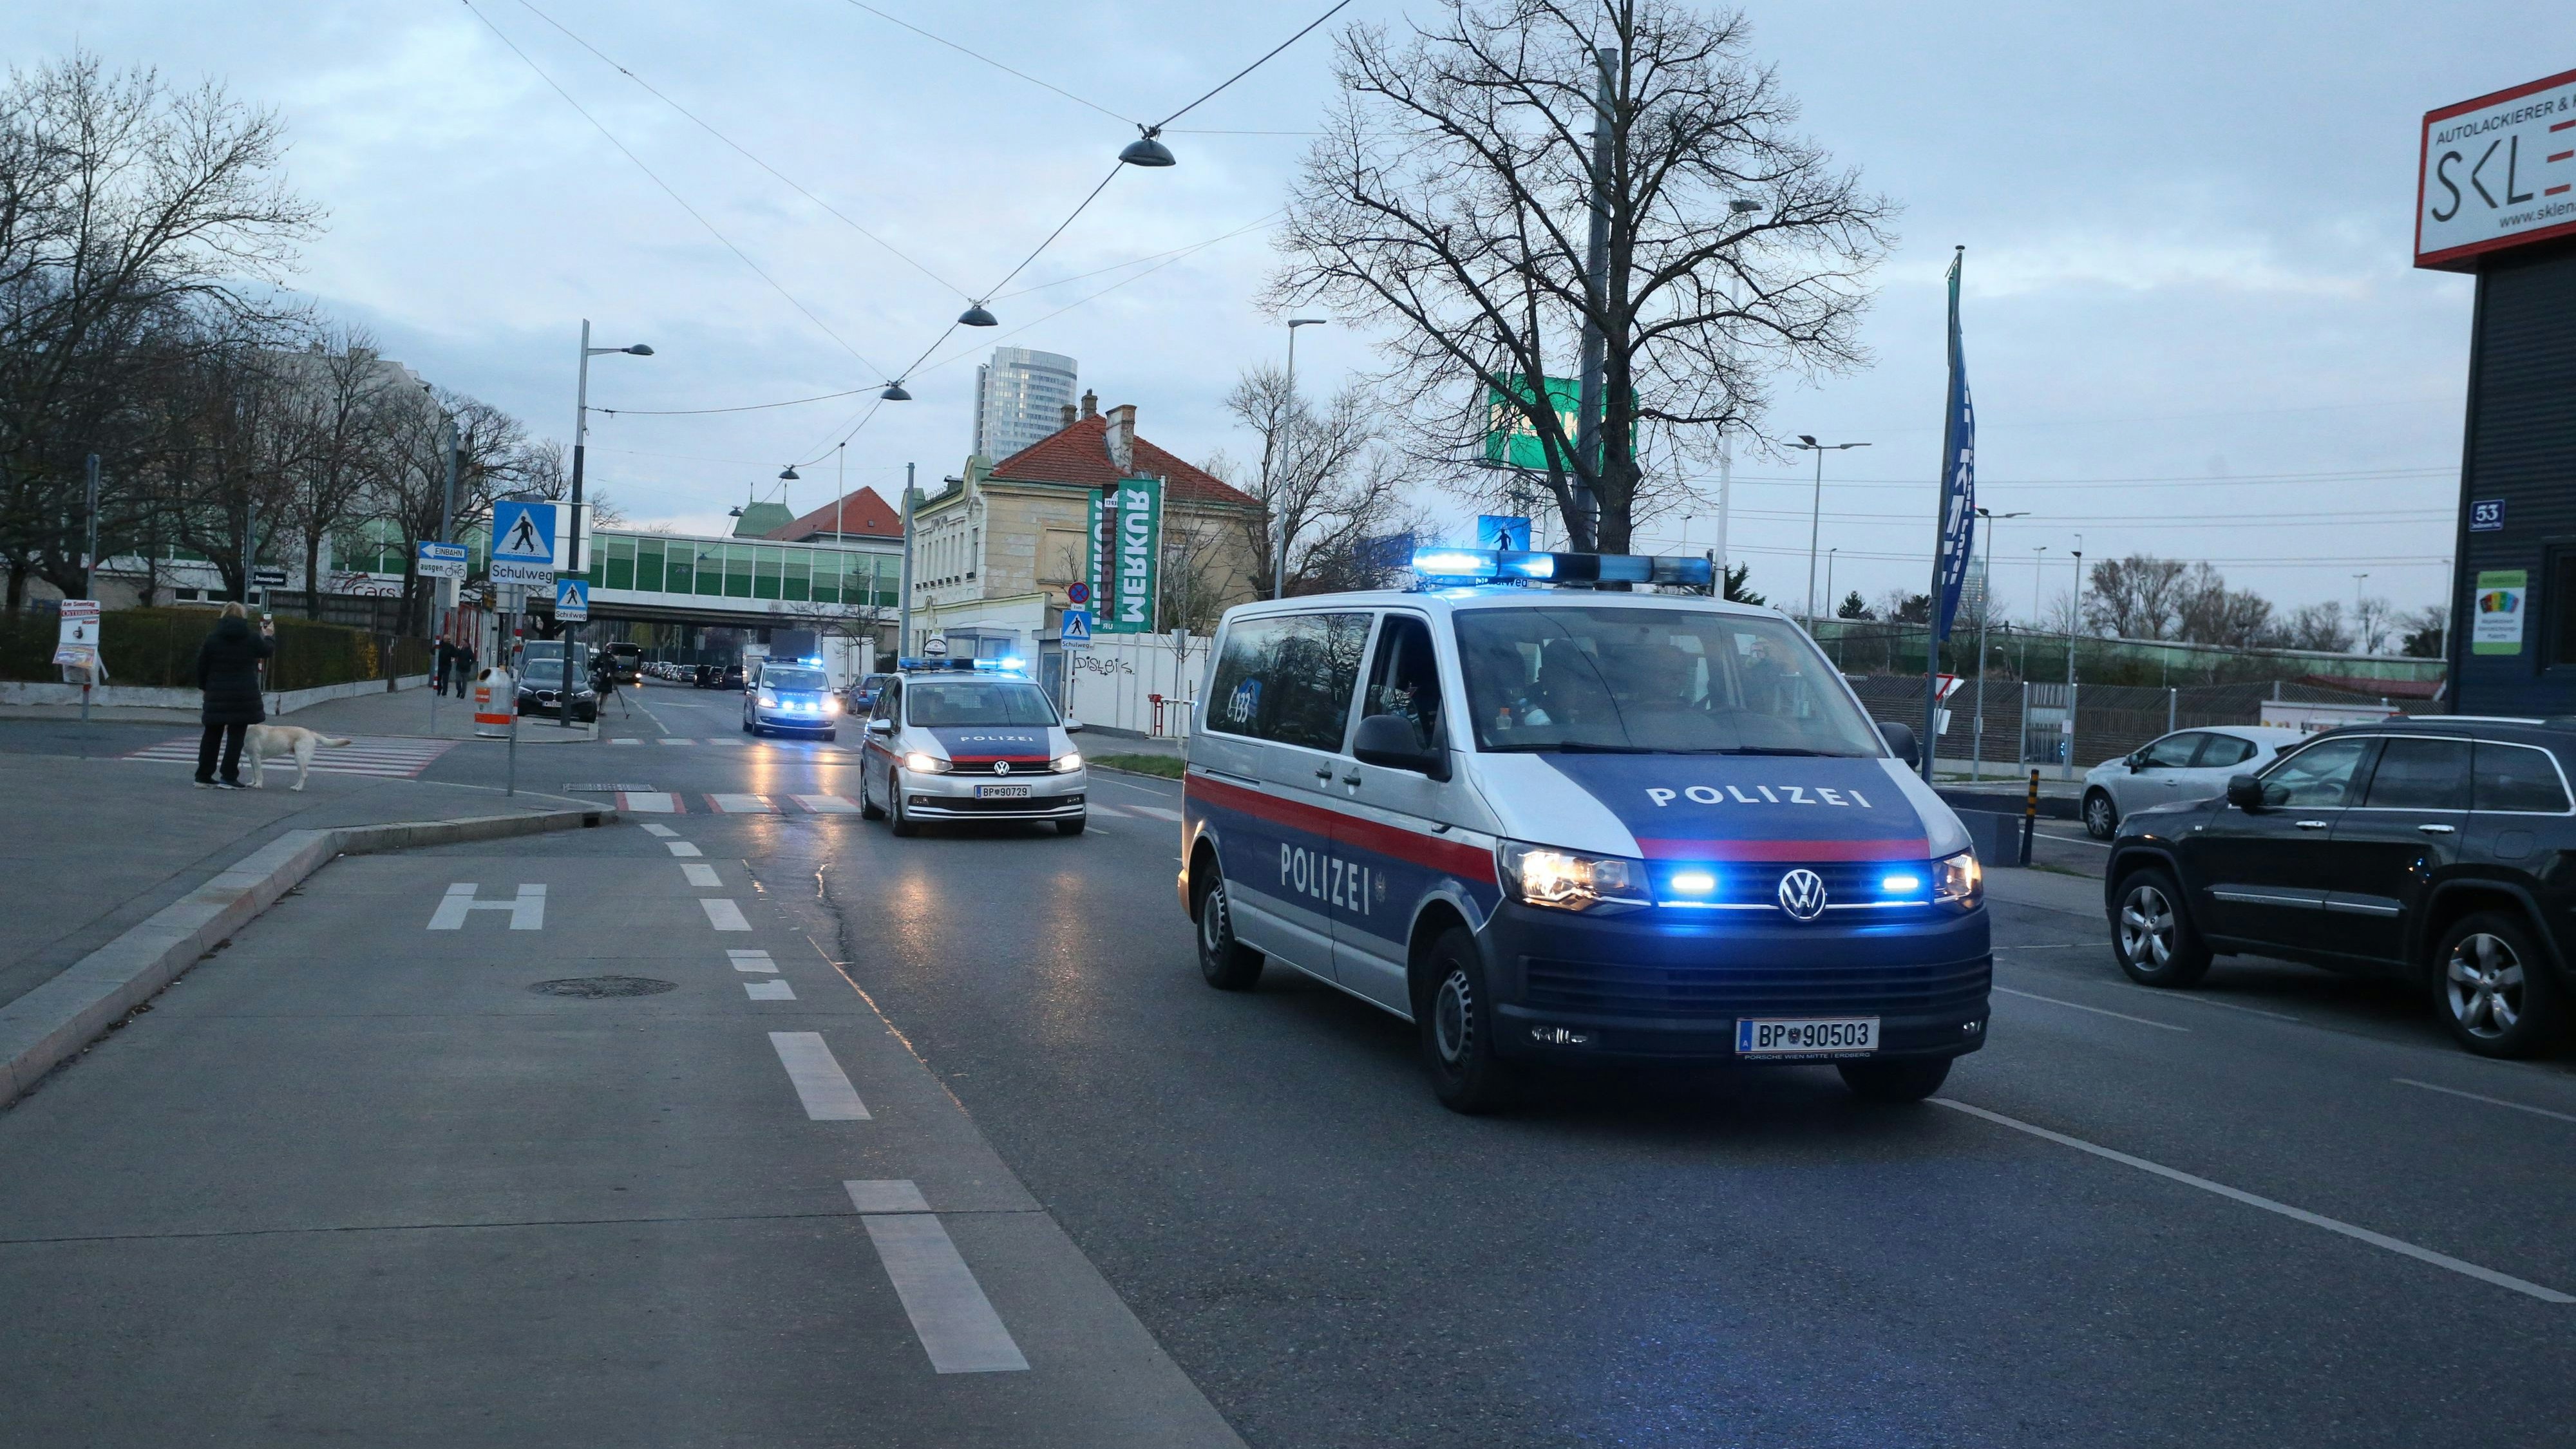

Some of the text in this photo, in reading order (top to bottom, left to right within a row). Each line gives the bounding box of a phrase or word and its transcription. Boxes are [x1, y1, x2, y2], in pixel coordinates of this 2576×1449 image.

[2436, 100, 2554, 145] AUTOLACKIERER
[2557, 97, 2568, 111] &
[2475, 504, 2499, 522] 53
[435, 547, 463, 557] EINBAHN
[420, 563, 445, 573] ausgen.
[492, 565, 553, 583] Schulweg
[556, 611, 587, 621] Schulweg
[1234, 692, 1251, 723] 133
[983, 787, 1028, 797] BP 90729
[1645, 784, 1872, 809] POLIZEI
[1280, 842, 1370, 916] POLIZEI
[426, 883, 547, 931] H
[1759, 1022, 1869, 1048] BP 90503
